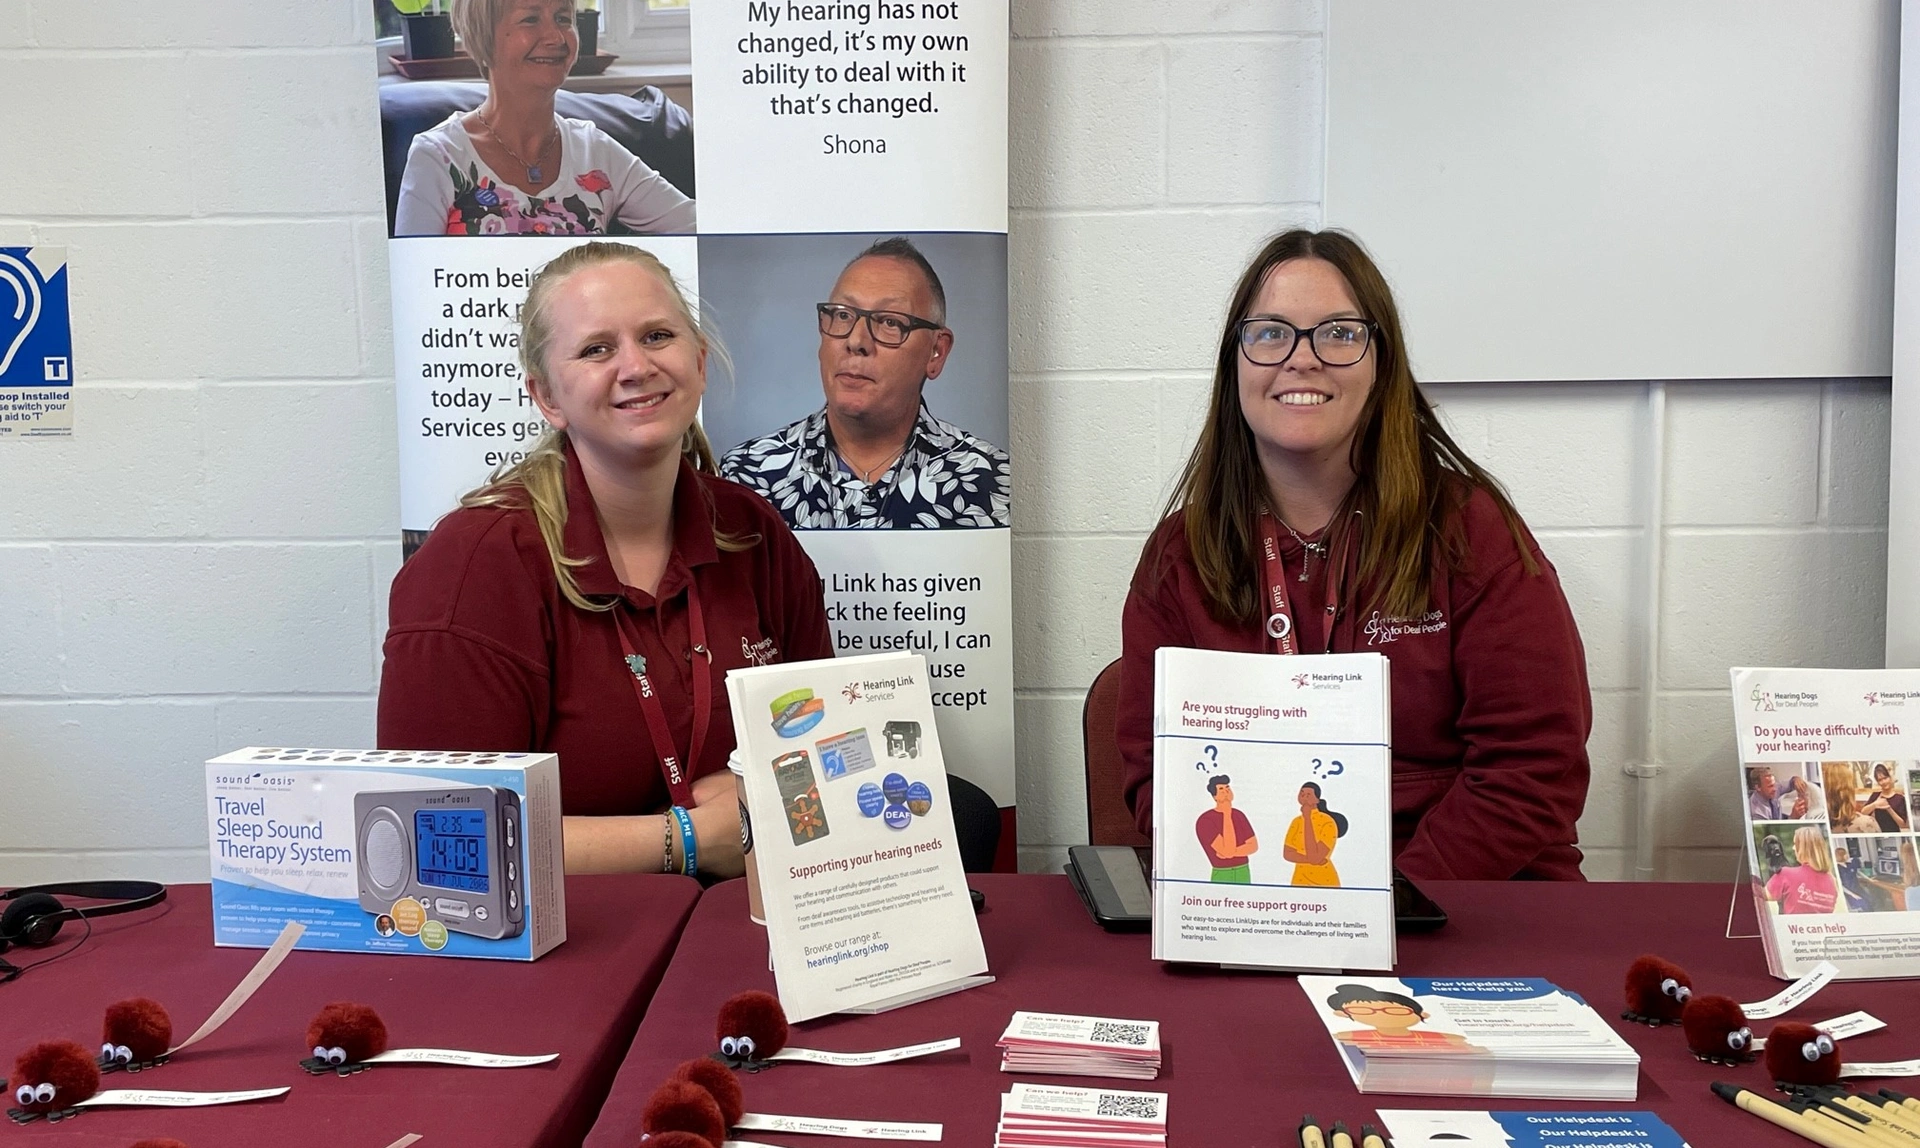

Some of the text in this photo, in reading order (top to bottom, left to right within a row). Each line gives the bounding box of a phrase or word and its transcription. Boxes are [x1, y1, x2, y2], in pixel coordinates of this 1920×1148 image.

[748, 0, 959, 27] My hearing has not
[737, 30, 969, 57] changed, it's my own
[742, 61, 966, 89] ability to deal with it
[770, 92, 939, 118] that's changed.
[823, 134, 887, 154] Shona
[434, 268, 489, 288] From
[442, 304, 453, 318] a
[460, 298, 508, 318] dark
[421, 328, 483, 348] didn't
[47, 360, 65, 377] T
[422, 363, 523, 383] anymore,
[22, 392, 69, 400] Installed
[431, 388, 492, 412] today
[12, 402, 42, 411] switch
[45, 403, 66, 412] your
[5, 413, 18, 421] aid
[21, 413, 31, 421] to
[421, 418, 506, 437] Services
[1264, 537, 1277, 561] Staff
[833, 573, 876, 592] Link
[882, 573, 917, 592] has
[924, 573, 981, 597] given
[1272, 585, 1285, 609] Staff
[826, 601, 966, 625] ck the feeling
[1423, 610, 1443, 621] Dogs
[1390, 621, 1448, 635] for Deaf People
[838, 630, 991, 652] be useful, I can
[930, 663, 966, 678] use
[1312, 673, 1363, 683] Hearing Link
[863, 675, 915, 690] Hearing Link
[1312, 682, 1341, 690] Services
[865, 692, 895, 703] Services
[931, 688, 987, 711] ccept
[1774, 692, 1800, 701] Hearing
[1801, 692, 1818, 701] Dogs
[1880, 692, 1906, 700] Hearing
[1182, 701, 1307, 719] Are you struggling with
[1182, 715, 1250, 731] hearing loss?
[1754, 724, 1900, 739] Do you have difficulty with
[1756, 740, 1831, 754] your hearing?
[664, 756, 682, 785] Staff
[216, 775, 250, 785] sound
[215, 796, 264, 816] Travel
[217, 818, 322, 841] Sleep Sound
[217, 839, 352, 866] Therapy System
[431, 838, 479, 872] 14:09
[789, 838, 943, 880] Supporting your hearing needs
[254, 866, 269, 876] help
[1181, 895, 1327, 913] Join our free support groups
[1193, 916, 1235, 924] easy-to-access
[1236, 917, 1259, 925] LinkUps
[1281, 919, 1313, 927] individuals
[1788, 923, 1847, 934] We can help
[1181, 933, 1204, 942] hearing
[1296, 929, 1328, 938] challenges
[1337, 931, 1354, 939] living
[804, 931, 882, 956] Browse our range at:
[807, 942, 890, 969] hearinglink.org/shop
[1554, 1116, 1618, 1124] Helpdesk
[1567, 1129, 1633, 1138] Helpdesk
